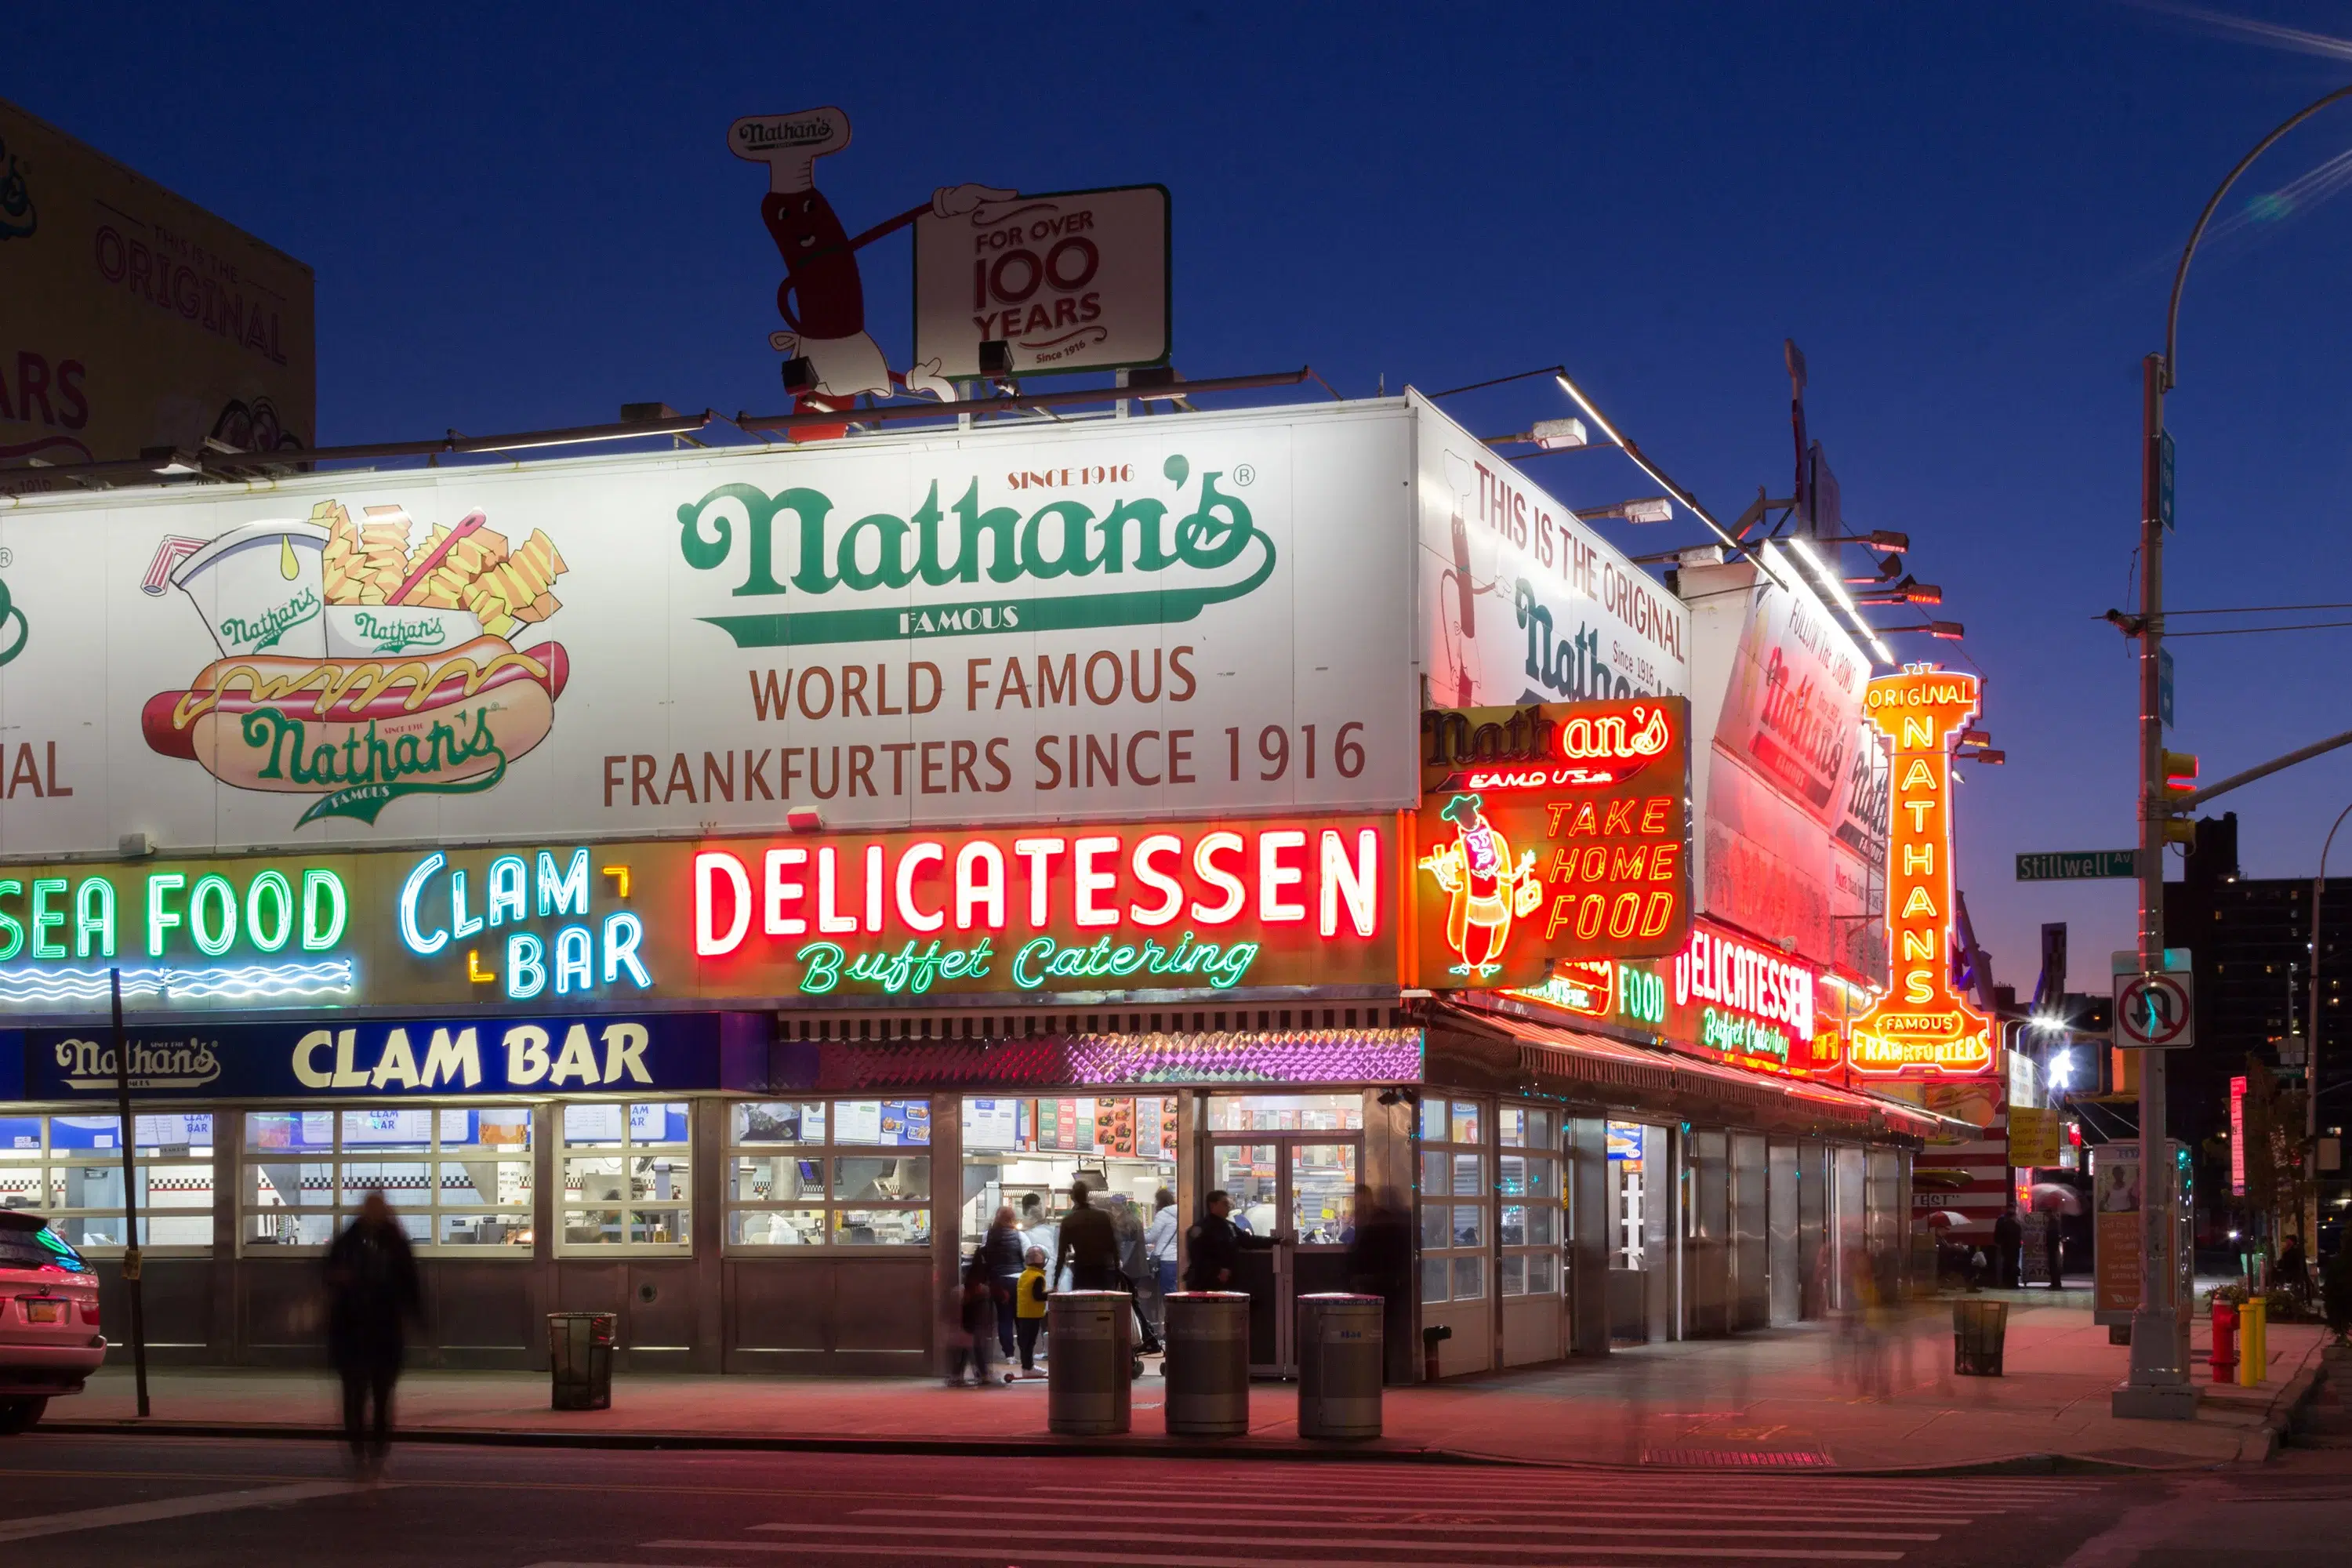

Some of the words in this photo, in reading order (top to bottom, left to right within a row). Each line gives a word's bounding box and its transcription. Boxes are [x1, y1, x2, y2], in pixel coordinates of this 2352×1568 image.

[739, 116, 833, 144] Nathan's
[975, 227, 1023, 254] FOR
[1029, 210, 1094, 241] OVER
[96, 224, 287, 367] ORIGINAL
[974, 236, 1099, 311] 100
[972, 292, 1102, 342] YEARS
[1036, 351, 1062, 364] Since
[1064, 340, 1086, 356] 1916
[1007, 466, 1076, 492] SINCE
[1078, 463, 1134, 486] 1916
[677, 453, 1276, 597] Nathan's
[1474, 459, 1527, 550] THIS
[1535, 506, 1553, 569] IS
[1559, 524, 1597, 602] THE
[1603, 561, 1685, 665] ORIGINAL
[220, 586, 321, 645] Nathan's
[354, 612, 445, 641] Nathan's
[898, 604, 1019, 635] FAMOUS
[1789, 597, 1820, 654] FOLLOW
[749, 659, 942, 722] WORLD
[966, 645, 1196, 712] FAMOUS
[1613, 640, 1634, 673] Since
[1636, 656, 1654, 687] 1916
[1868, 681, 1973, 707] ORIGINAL
[241, 706, 506, 786] Nathan's
[604, 735, 1011, 808] FRANKFURTERS
[1035, 728, 1197, 790] SINCE
[1223, 720, 1367, 783] 1916
[1421, 706, 1669, 767] Nathan's
[0, 739, 74, 801] AL
[330, 785, 390, 808] FAMOUS
[1547, 799, 1671, 838] TAKE
[1549, 844, 1678, 884] HOME
[1900, 715, 1938, 1005] NATHANS
[2020, 854, 2110, 880] Stillwell
[0, 877, 115, 961] SEA
[147, 868, 350, 959] FOOD
[401, 847, 592, 956] CLAM
[694, 829, 1377, 957] DELICATESSEN
[1545, 892, 1673, 941] FOOD
[506, 911, 655, 1000] BAR
[797, 936, 992, 996] Buffet
[1011, 931, 1259, 989] Catering
[1618, 965, 1664, 1023] FOOD
[1675, 931, 1813, 1042] DELICATESSEN
[1704, 1007, 1745, 1051] Buffet
[1746, 1018, 1790, 1065] Catering
[1853, 1029, 1989, 1062] FRANKFURTERS
[1886, 1017, 1953, 1030] FAMOUS
[292, 1027, 484, 1090] CLAM
[504, 1022, 656, 1088] BAR
[187, 1123, 208, 1133] BAR
